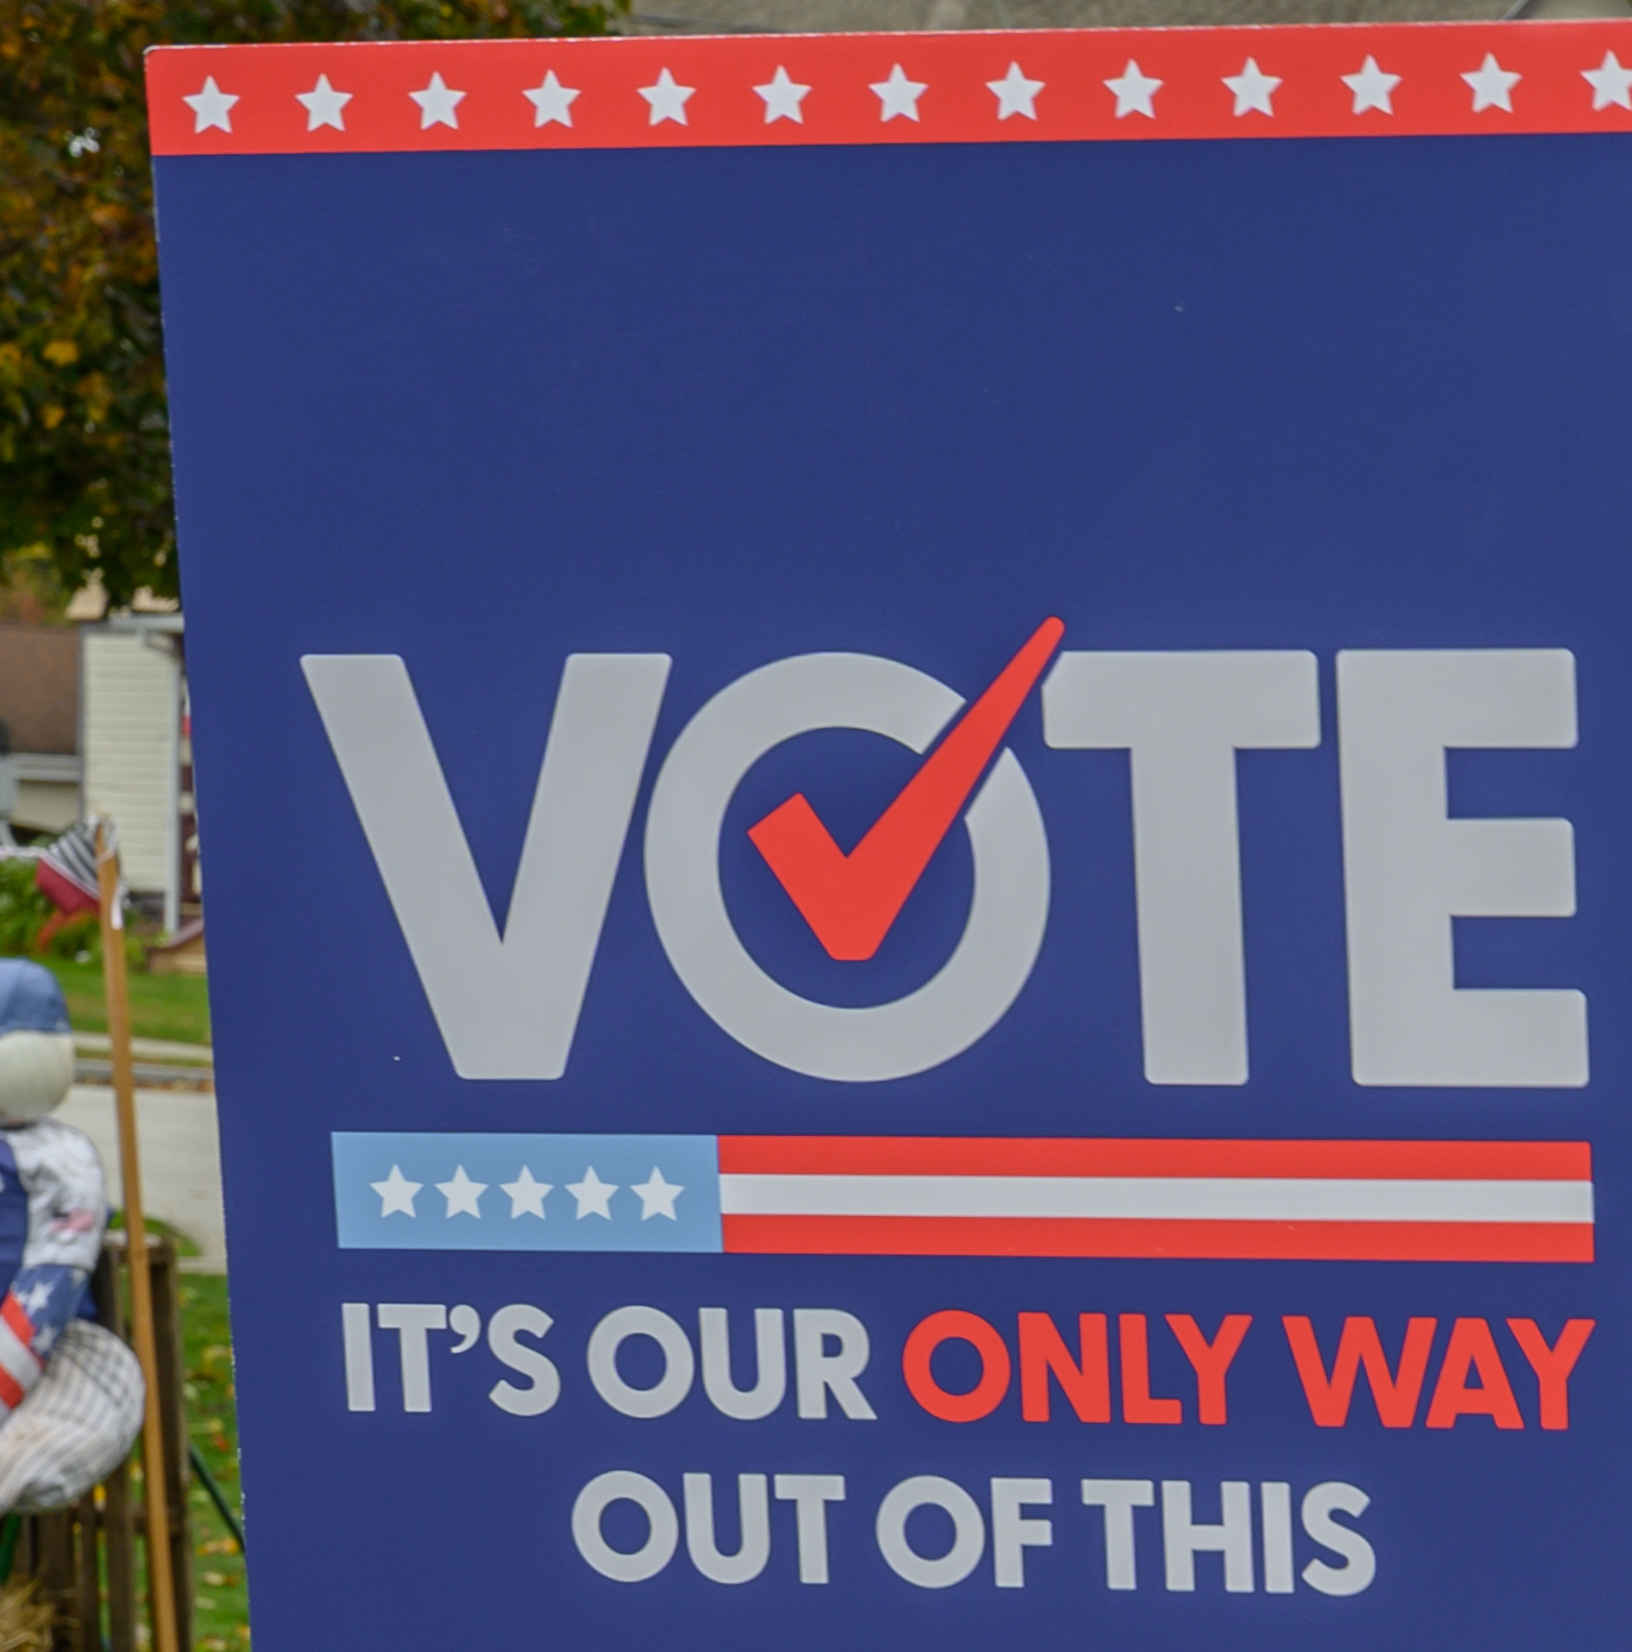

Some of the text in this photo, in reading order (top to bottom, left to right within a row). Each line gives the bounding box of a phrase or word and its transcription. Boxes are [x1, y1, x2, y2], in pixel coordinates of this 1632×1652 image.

[300, 648, 1590, 1087] VOTE
[342, 1303, 1597, 1430] IT'S OUR ONLY WAY
[571, 1470, 1376, 1596] OUT OF THIS
